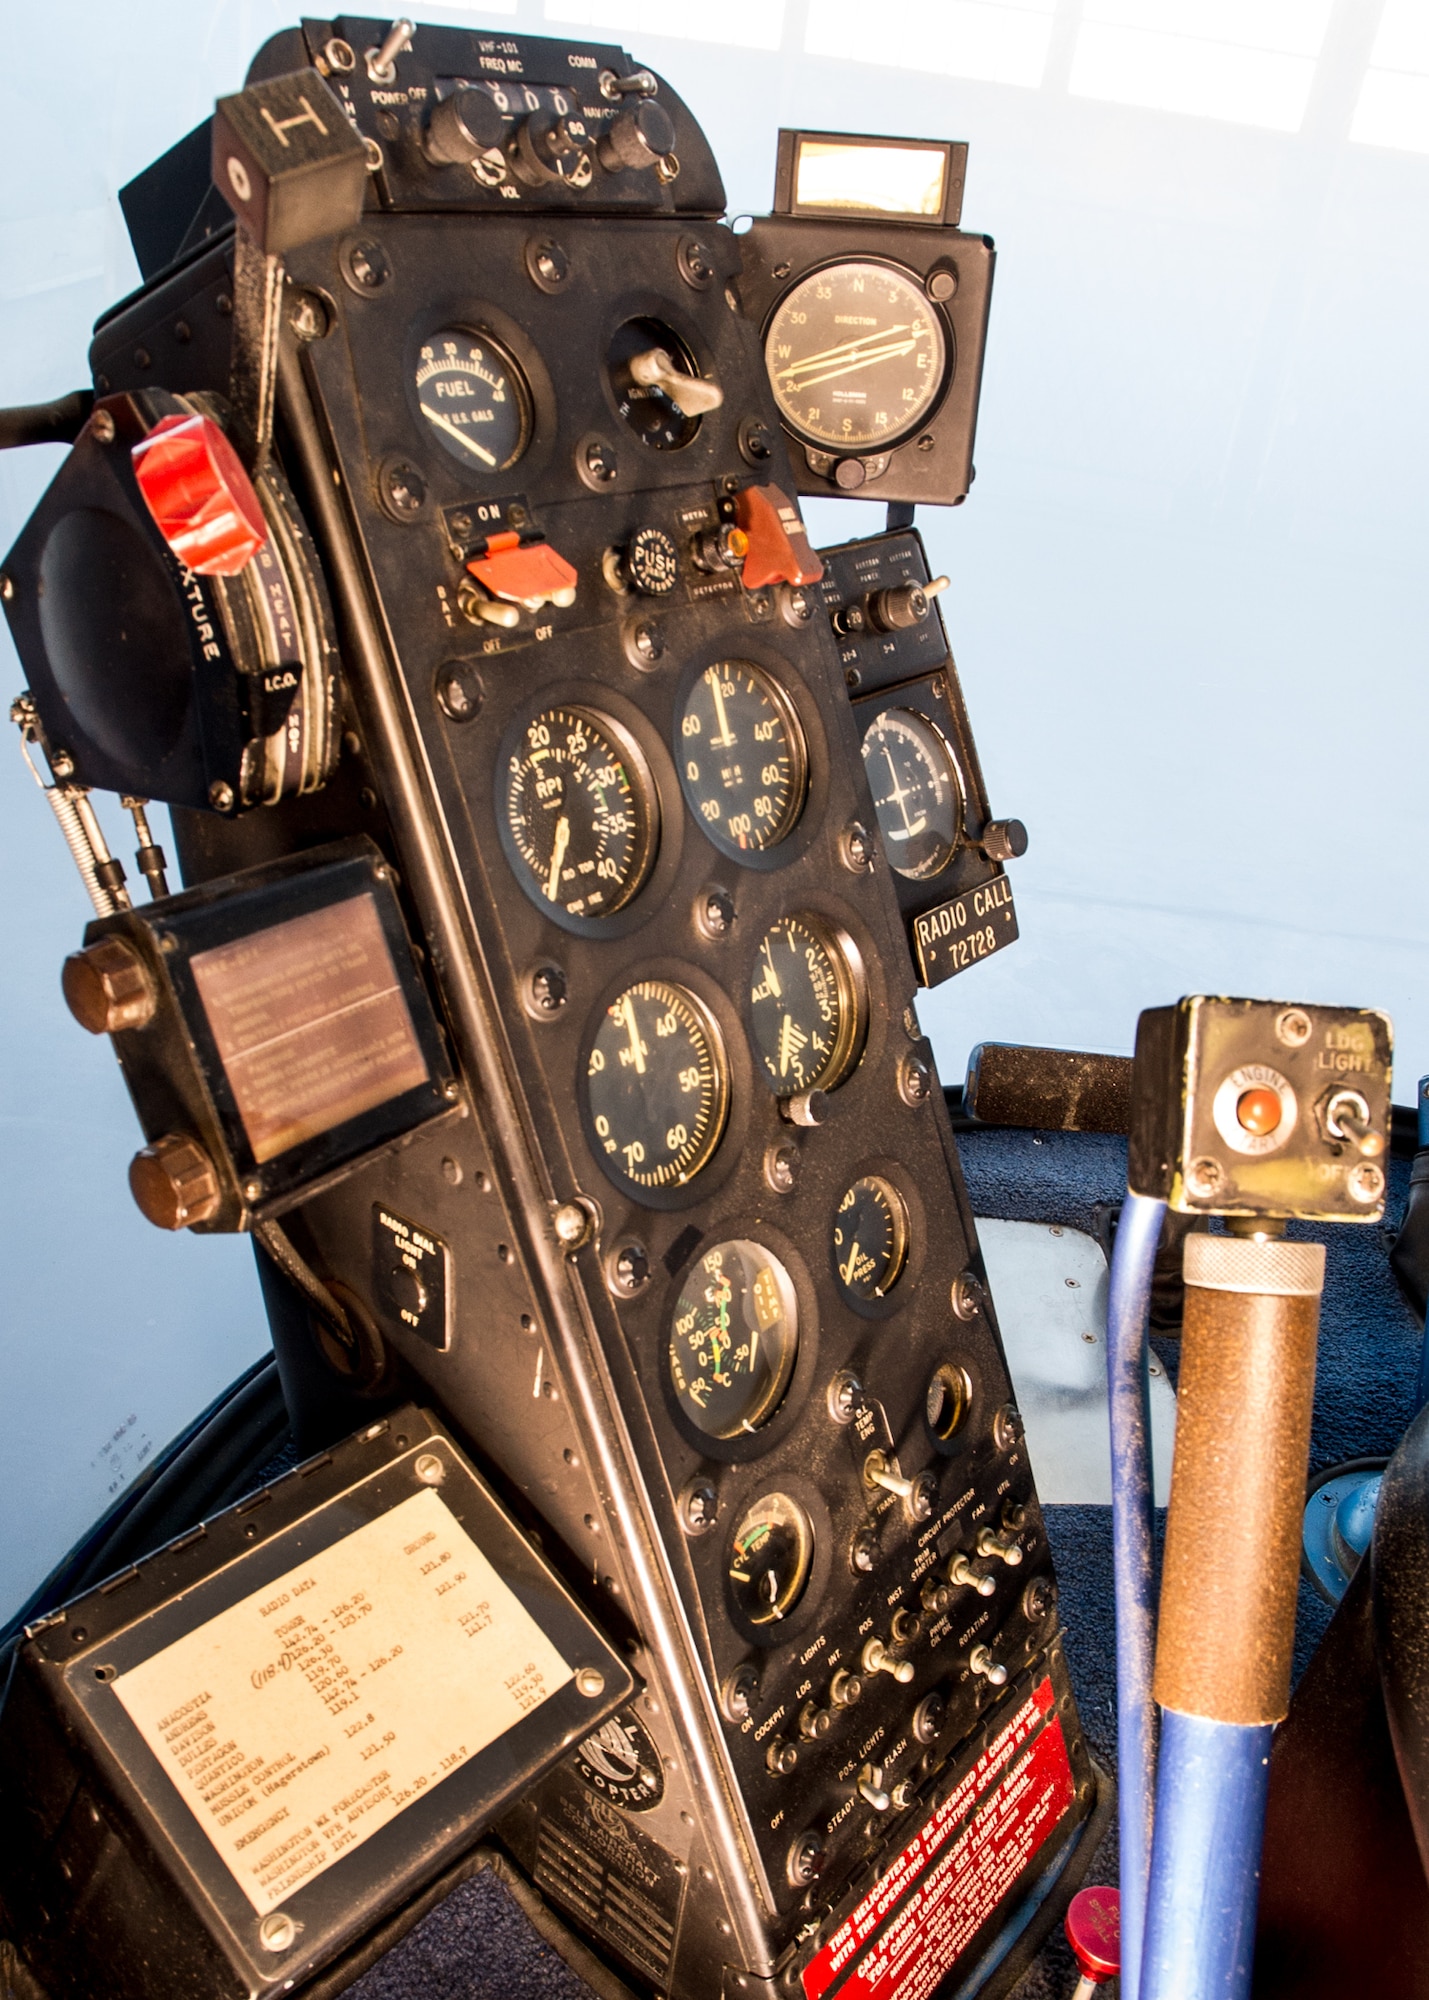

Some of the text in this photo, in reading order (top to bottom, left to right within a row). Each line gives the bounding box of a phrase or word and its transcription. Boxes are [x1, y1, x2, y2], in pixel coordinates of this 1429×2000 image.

[479, 57, 524, 74] FREQ MC
[567, 54, 598, 69] COMM
[407, 86, 428, 100] OFF
[567, 120, 586, 136] SQ
[500, 186, 521, 199] VOL
[852, 279, 865, 293] N
[790, 313, 807, 325] 30
[834, 315, 878, 326] DIRECTION
[778, 345, 792, 359] W
[916, 353, 927, 369] E
[435, 380, 475, 398] FUEL
[902, 388, 915, 401] 12
[808, 407, 820, 420] 21
[841, 418, 852, 432] S
[875, 411, 888, 425] 15
[477, 504, 502, 522] ON
[682, 510, 709, 522] METAL
[634, 545, 676, 573] PUSH
[693, 581, 734, 597] DETECTOR
[269, 583, 292, 648] HEAT
[535, 625, 553, 641] OFF
[721, 682, 735, 698] 20
[527, 725, 549, 749] 20
[754, 721, 773, 742] 40
[566, 734, 587, 755] 25
[597, 769, 616, 788] 30
[761, 764, 780, 786] 60
[753, 795, 773, 818] 80
[608, 812, 627, 835] 35
[728, 813, 751, 837] 100
[597, 857, 617, 879] 40
[918, 880, 1013, 947] RADIO CALL
[805, 948, 817, 971] 2
[948, 925, 997, 969] 72728
[819, 1001, 832, 1022] 3
[656, 1013, 677, 1037] 40
[1325, 1032, 1364, 1050] LDG
[1318, 1051, 1373, 1072] LIGHT
[678, 1066, 699, 1092] 50
[1232, 1066, 1288, 1094] ENGINE
[666, 1123, 687, 1150] 60
[622, 1141, 645, 1166] 70
[379, 1212, 437, 1256] RADIO DIAL
[394, 1234, 424, 1260] LIGHT
[854, 1252, 869, 1266] OIL
[853, 1258, 876, 1280] PRESS
[675, 1315, 694, 1335] 100
[688, 1333, 705, 1350] 50
[855, 1411, 874, 1432] TEMP
[860, 1422, 876, 1441] ENG
[996, 1479, 1011, 1496] UTIL
[876, 1494, 898, 1515] TRANS
[971, 1502, 986, 1521] FAN
[917, 1487, 976, 1549] CIRCUIT PROTECTOR
[403, 1531, 438, 1556] GROUND
[420, 1551, 452, 1576] 121.80
[732, 1553, 750, 1570] CYL
[910, 1551, 938, 1582] STARTER
[914, 1548, 930, 1567] TRIM
[434, 1571, 468, 1597] 121.90
[887, 1586, 905, 1606] INST.
[258, 1577, 318, 1618] RADIO DATA
[331, 1592, 365, 1619] 126.20
[338, 1602, 373, 1629] 123.70
[457, 1601, 491, 1627] 121.70
[958, 1611, 990, 1649] ROTATING
[800, 1635, 827, 1666] LIGHTS
[827, 1648, 843, 1667] INT.
[305, 1654, 342, 1683] 119.70
[312, 1665, 349, 1694] 120.60
[320, 1644, 404, 1705] 142.74 126.20
[503, 1662, 537, 1690] 122.60
[511, 1672, 544, 1701] 119.30
[518, 1686, 548, 1711] 121.9
[795, 1679, 813, 1700] LDG
[157, 1691, 213, 1732] ANACOSTIA
[328, 1691, 360, 1717] 119.1
[164, 1709, 208, 1744] ANDREWS
[343, 1712, 376, 1739] 122.8
[740, 1716, 755, 1734] ON
[753, 1705, 786, 1742] COCKPIT
[170, 1721, 216, 1756] DAVISON
[359, 1731, 397, 1761] 121.50
[178, 1737, 218, 1768] DULLES
[186, 1739, 238, 1780] PENTAGON
[837, 1726, 886, 1782] POS. LIGHTS
[883, 1738, 908, 1769] FLASH
[193, 1751, 246, 1791] QUANTICO
[201, 1755, 266, 1803] WASHINGTON
[251, 1752, 297, 1786] CONTROL
[217, 1744, 332, 1827] UNICOM (Hagerstown)
[252, 1769, 392, 1875] WASHINGTON FORECASTER
[770, 1809, 785, 1830] OFF
[826, 1797, 856, 1834] STEADY
[827, 1697, 1036, 1952] THIS HELICOPTER TO BE OPERATED IN COMPLIANCE
[233, 1805, 291, 1852] EMERGENCY
[259, 1784, 394, 1888] WASHINGTON ADVISORY
[267, 1775, 428, 1900] FRIENDSHIP 126.20
[829, 1707, 1042, 1973] WITH THE OPERATING LIMITATIONS SPECIFIED IN THE
[562, 1806, 655, 1888] CORPORATION
[857, 1951, 877, 1979] CAA
[878, 1892, 923, 1954] APPROVED
[923, 1824, 974, 1895] ROTORCRAFT
[974, 1789, 1003, 1829] FLIGHT
[866, 1954, 889, 1984] FOR
[889, 1919, 918, 1957] CABIN
[916, 1871, 954, 1922] LOADING
[953, 1847, 971, 1874] SEE
[970, 1812, 999, 1852] FLIGHT
[999, 1773, 1031, 1816] MANUAL
[994, 1856, 1029, 1903] PERMITTED
[889, 1932, 923, 1980] MINIMUM
[926, 1901, 946, 1931] PILOT
[949, 1864, 975, 1900] WEIGHT
[993, 1807, 1020, 1843] POUNDS
[923, 1850, 996, 1949] AIRSPEED LIMITATIONS
[939, 1837, 1034, 1965] REARWARD FLIGHT PROHIBITED
[930, 1915, 966, 1965] DECREASE
